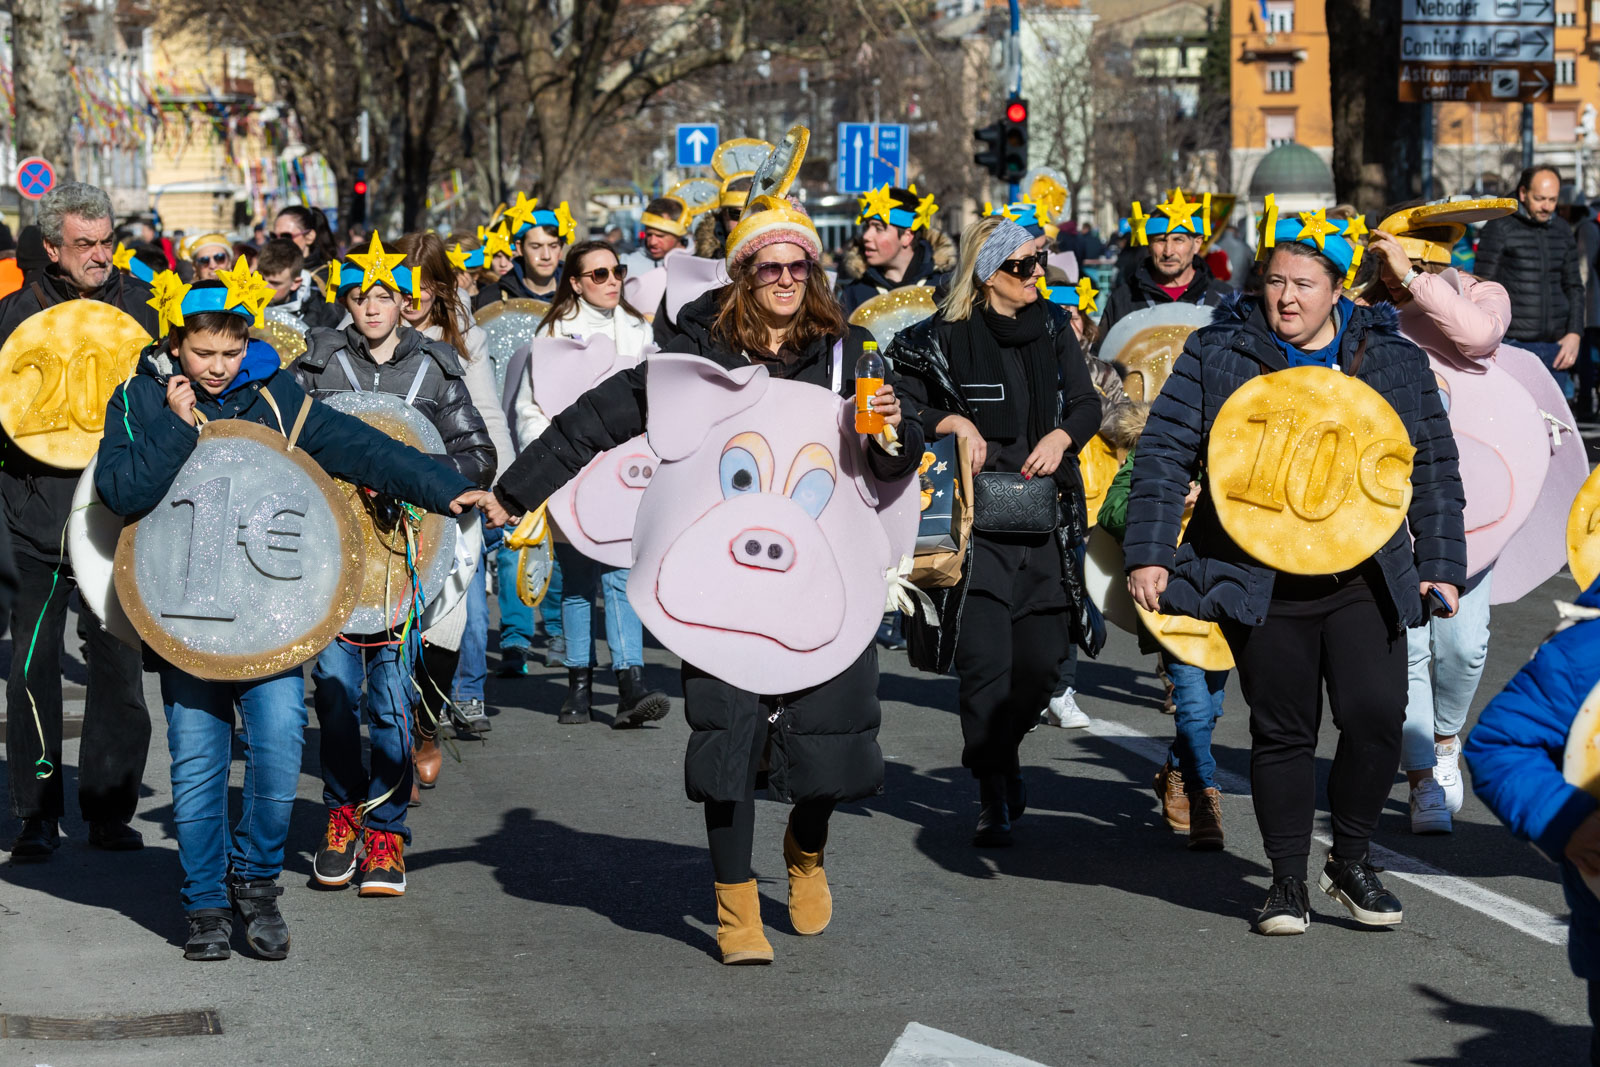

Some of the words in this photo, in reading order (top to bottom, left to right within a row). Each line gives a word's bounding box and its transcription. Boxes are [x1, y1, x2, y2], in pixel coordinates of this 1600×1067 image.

[1416, 0, 1480, 16] Neboder
[1403, 37, 1492, 57] Continental
[1401, 65, 1492, 82] Astronomski
[1422, 84, 1469, 100] centar
[1226, 408, 1418, 522] 10c
[161, 476, 309, 622] 1€
